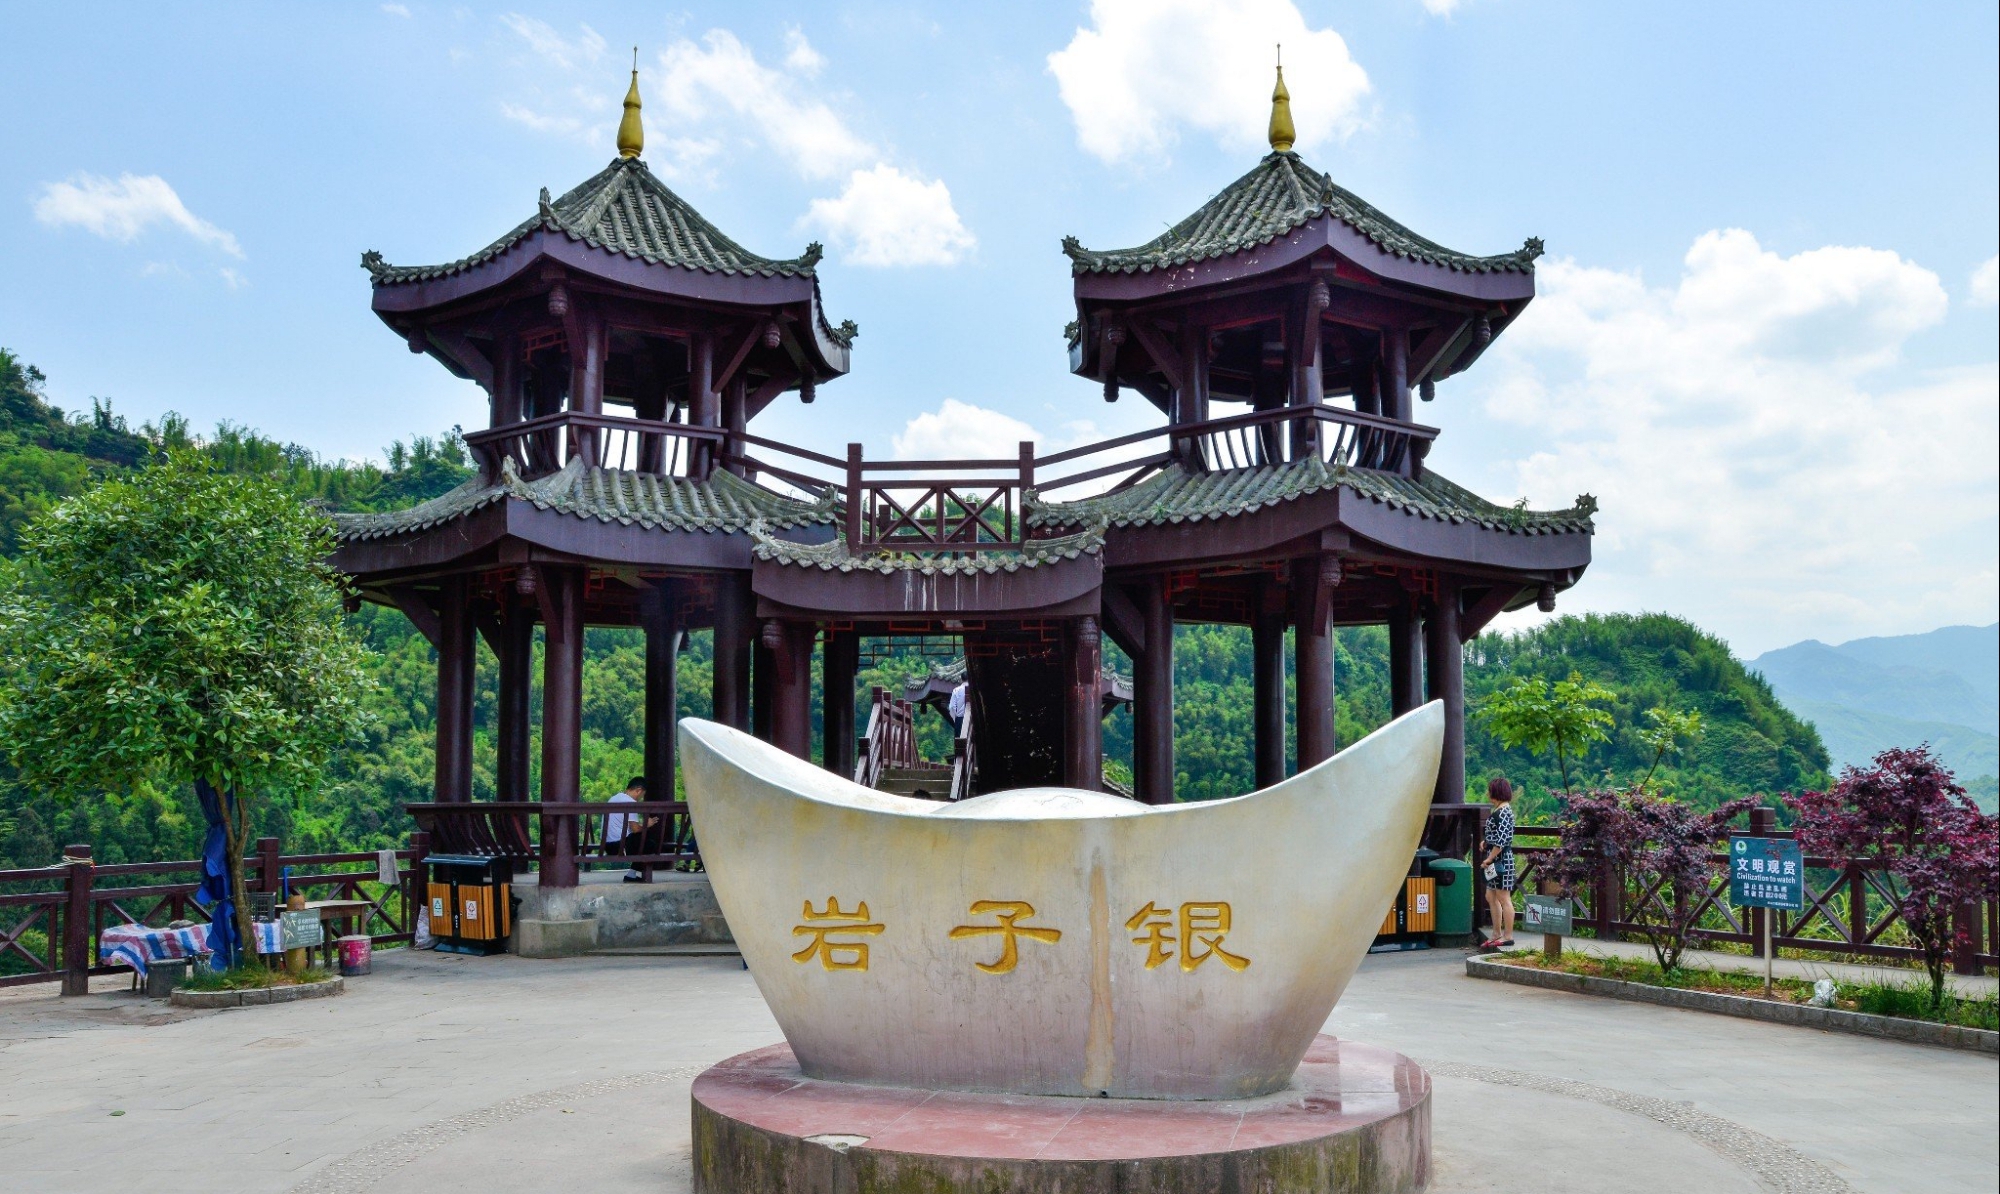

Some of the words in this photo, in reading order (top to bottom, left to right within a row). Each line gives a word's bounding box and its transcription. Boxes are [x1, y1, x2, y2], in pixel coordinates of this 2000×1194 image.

[1736, 858, 1796, 875] 文明观赏
[1737, 873, 1769, 882] Civilization
[1777, 876, 1796, 884] watch
